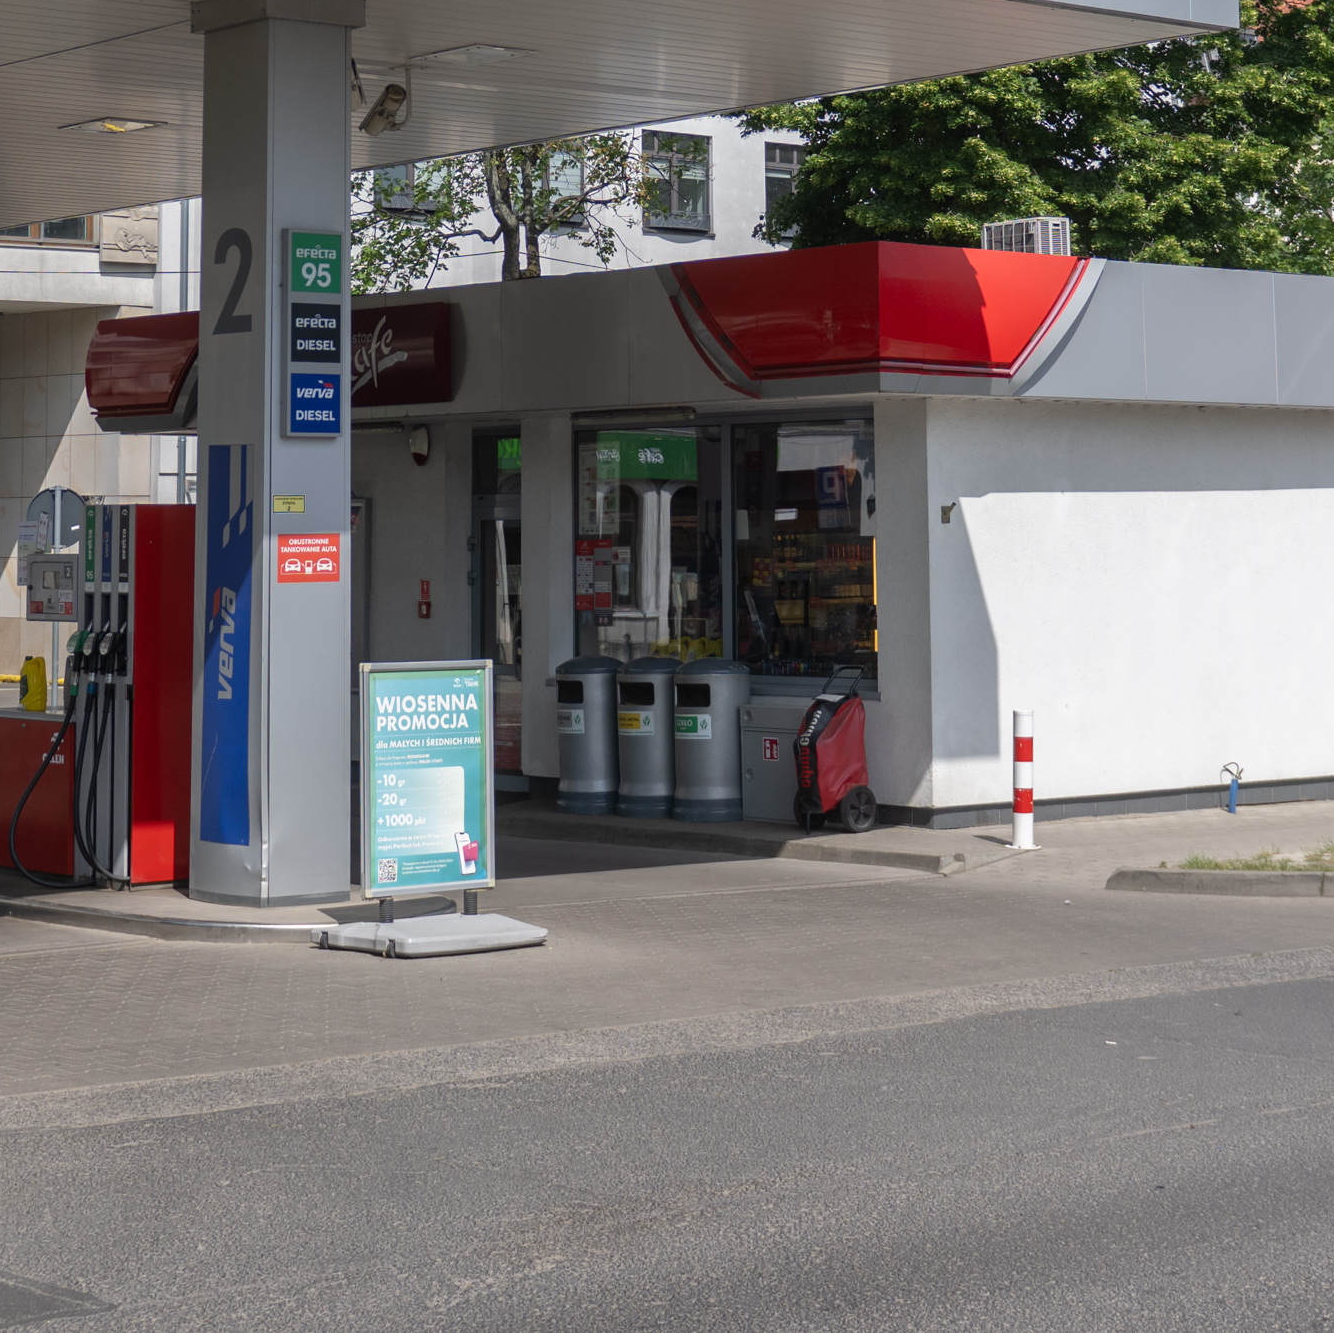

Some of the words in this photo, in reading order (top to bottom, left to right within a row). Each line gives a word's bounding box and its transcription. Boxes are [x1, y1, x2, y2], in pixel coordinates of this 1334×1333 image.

[296, 247, 337, 260] efecta
[212, 227, 253, 336] 2
[301, 262, 332, 288] 95
[295, 317, 336, 328] efecta
[296, 339, 336, 351] DIESEL
[352, 332, 373, 345] stop
[351, 315, 393, 389] afe
[296, 387, 334, 399] verva
[296, 410, 336, 421] DIESEL
[321, 545, 337, 553] AUTA
[217, 586, 237, 700] verva
[376, 693, 478, 714] WIOSENNA
[376, 712, 469, 732] PROMOCJA
[376, 740, 388, 749] dla
[389, 738, 420, 748] MAŁYCH
[426, 736, 462, 746] ŚREDNICH
[463, 736, 482, 745] FIRM
[42, 753, 65, 765] OLEN
[377, 774, 397, 787] -10
[397, 778, 406, 788] gr
[377, 793, 398, 806] -20
[399, 797, 407, 807] gr
[377, 813, 413, 827] +1000
[414, 816, 426, 827] pkt
